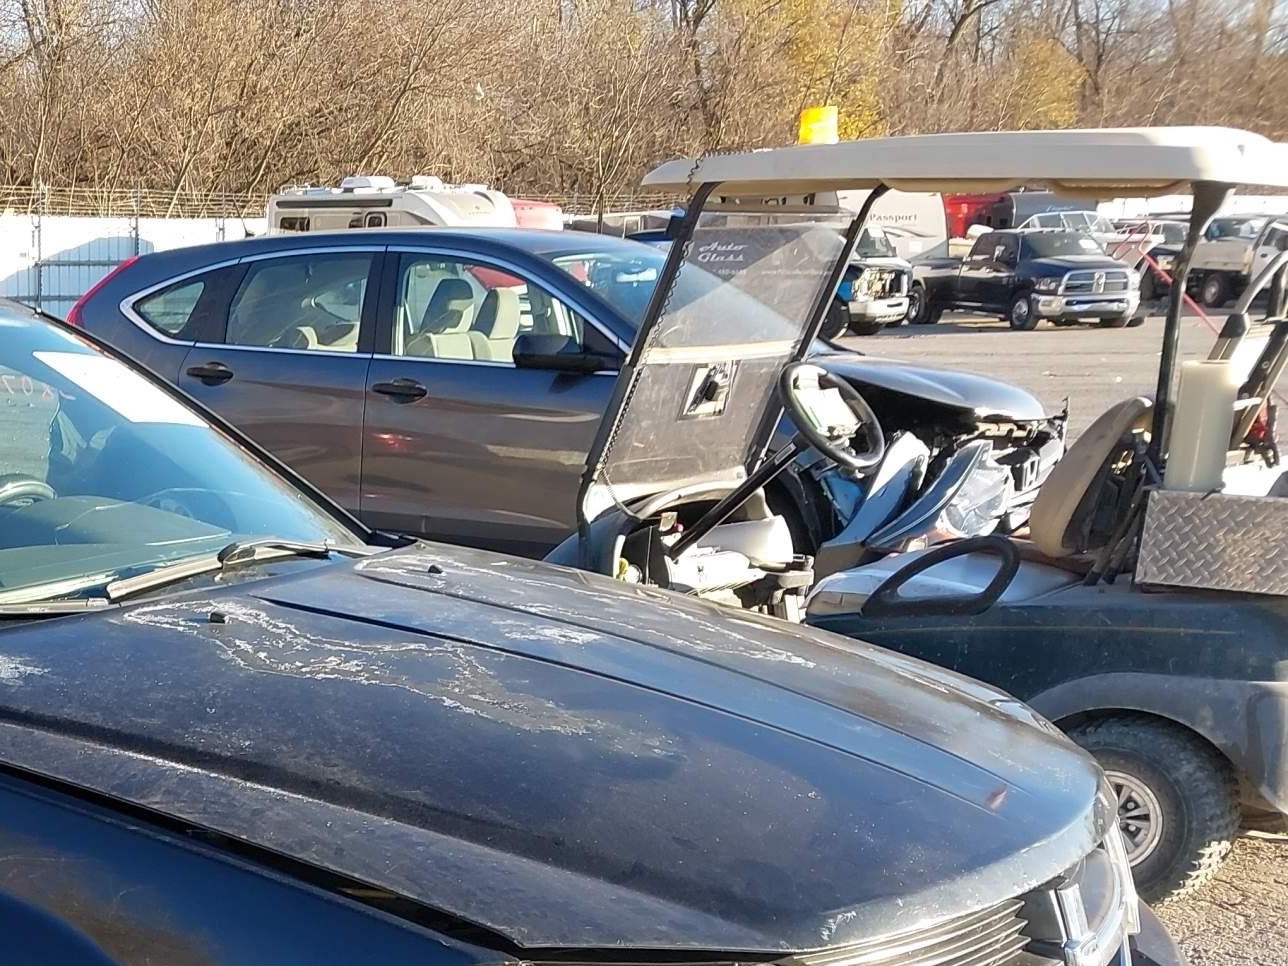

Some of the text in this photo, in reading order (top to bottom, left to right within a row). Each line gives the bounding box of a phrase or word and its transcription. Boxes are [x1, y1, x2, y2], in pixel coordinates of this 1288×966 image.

[869, 212, 918, 223] Passport
[698, 240, 748, 252] Auto
[697, 252, 744, 263] Glass
